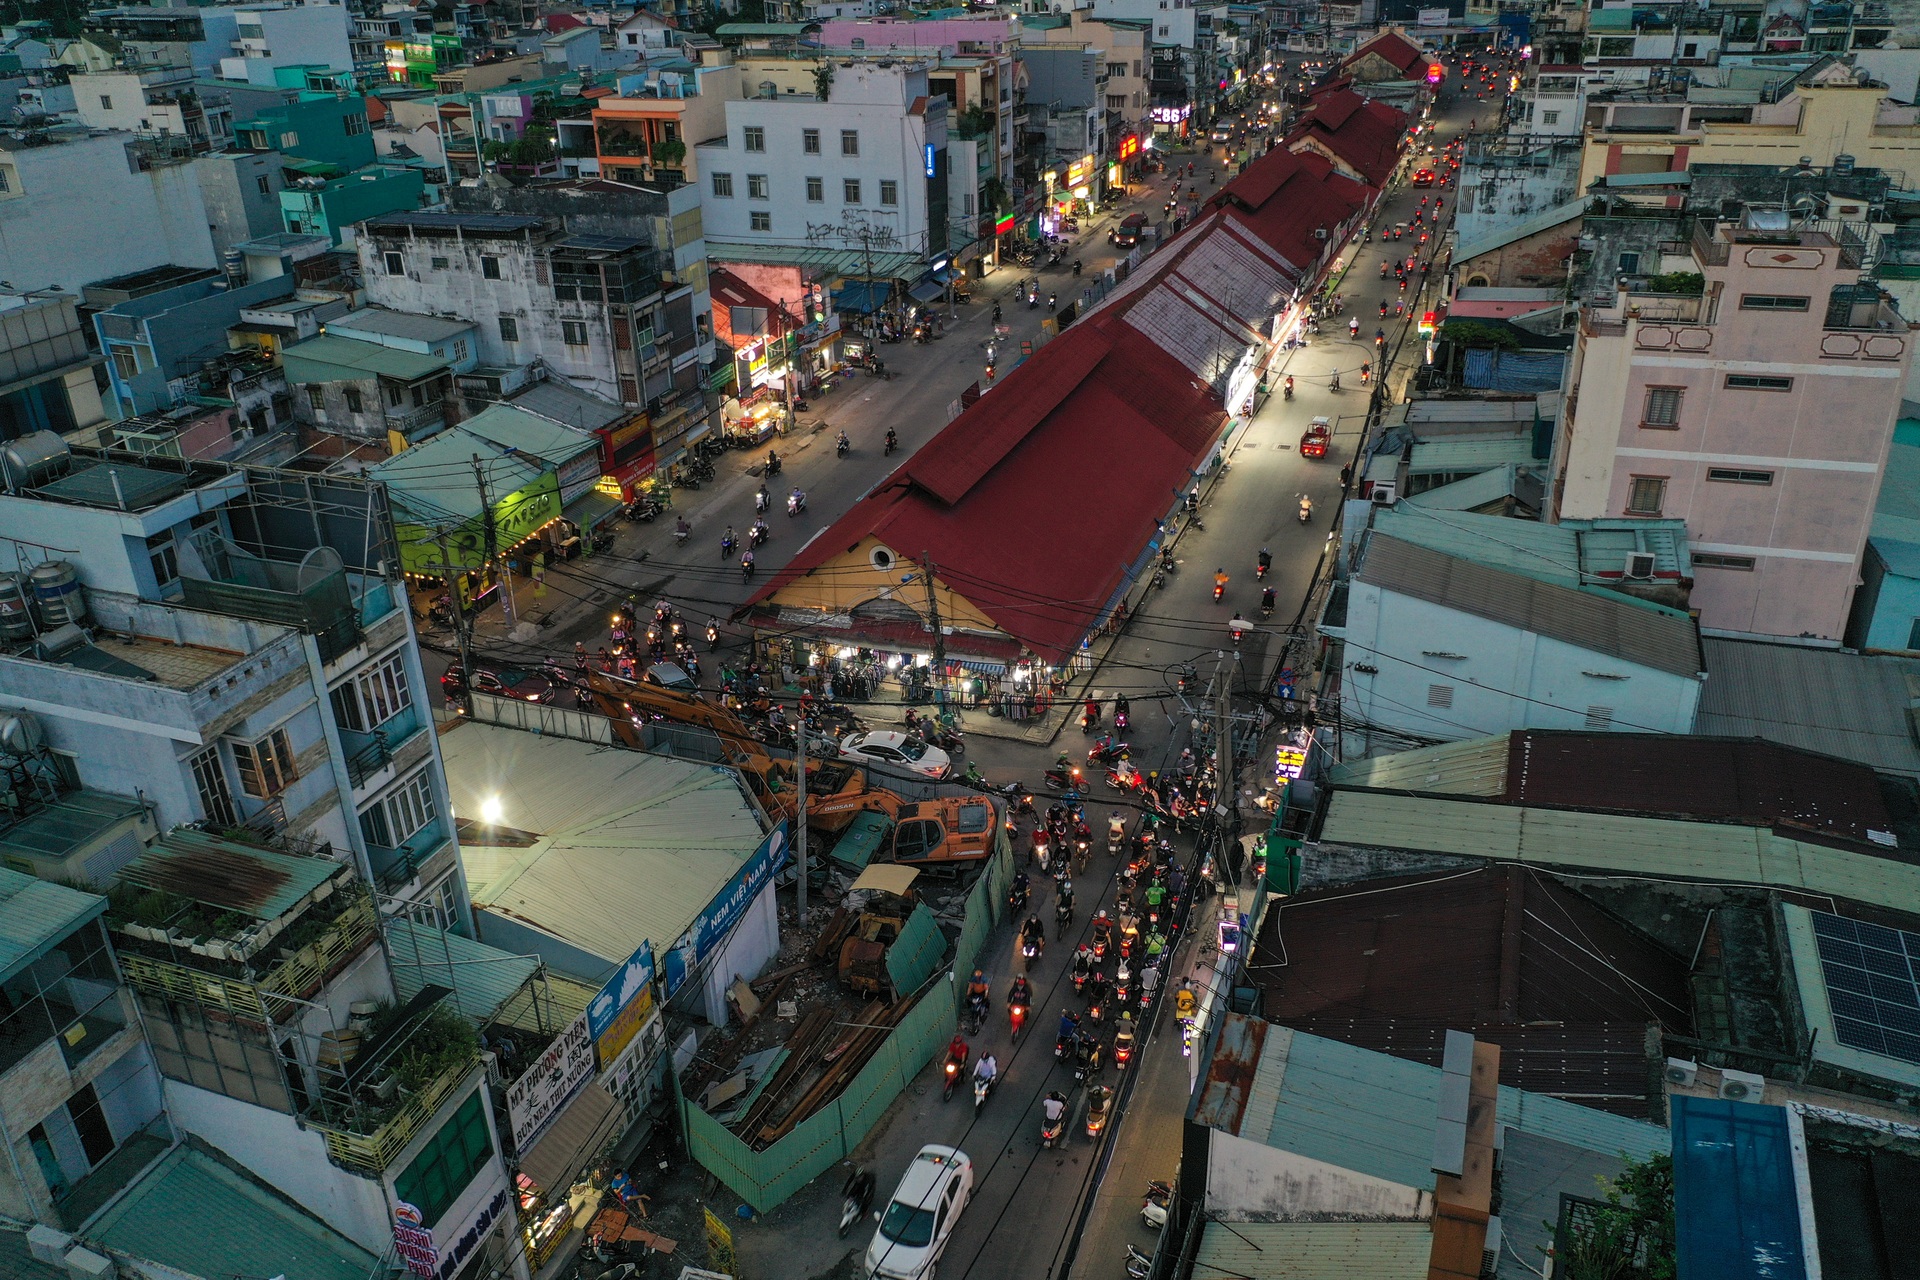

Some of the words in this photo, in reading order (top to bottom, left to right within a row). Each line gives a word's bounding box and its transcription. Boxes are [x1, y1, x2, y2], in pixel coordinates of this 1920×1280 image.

[1162, 108, 1180, 123] 86
[710, 902, 729, 930] NEM
[748, 859, 767, 888] NAM
[533, 1101, 550, 1127] NEM
[393, 1226, 431, 1248] SUSHI
